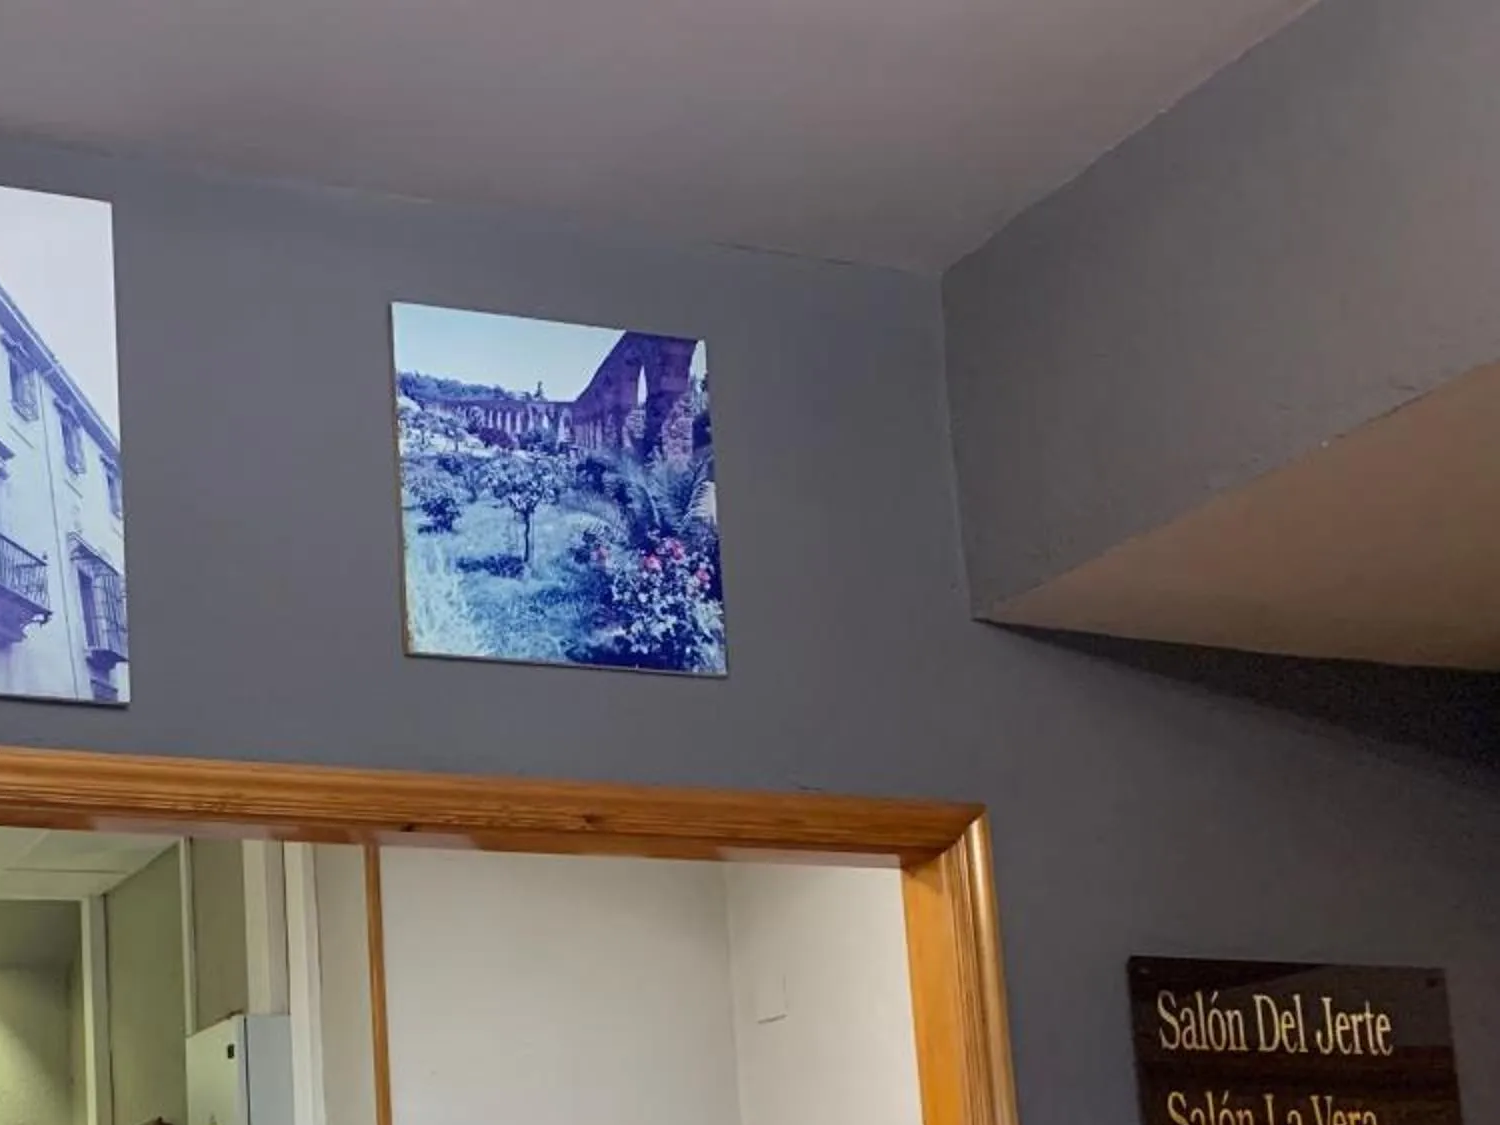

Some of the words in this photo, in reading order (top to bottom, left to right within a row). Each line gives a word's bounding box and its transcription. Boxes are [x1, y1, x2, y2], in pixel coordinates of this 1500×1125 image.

[1157, 990, 1247, 1051] Salón
[1253, 994, 1308, 1053] Del
[1315, 996, 1392, 1056] Jerte
